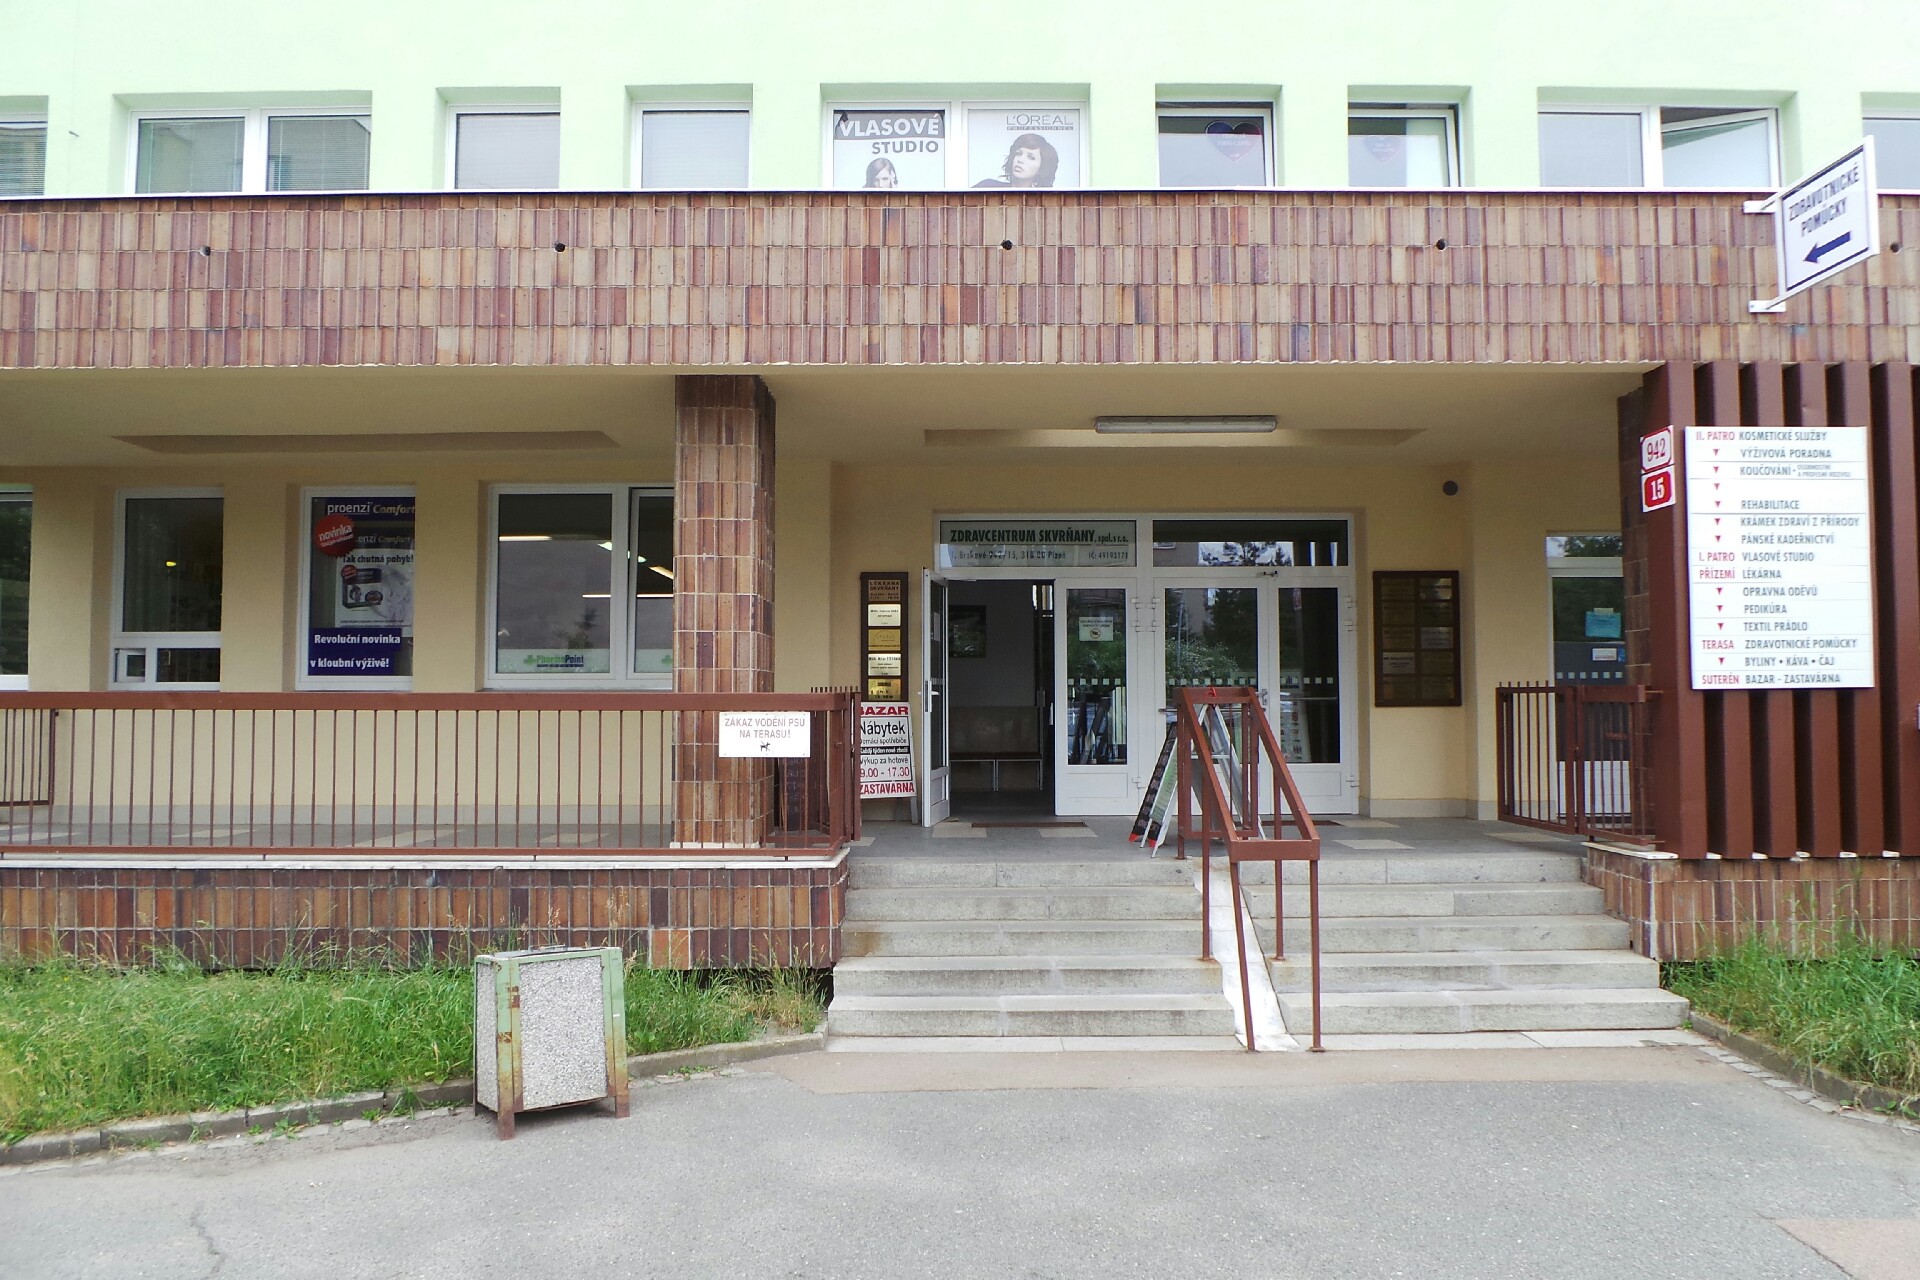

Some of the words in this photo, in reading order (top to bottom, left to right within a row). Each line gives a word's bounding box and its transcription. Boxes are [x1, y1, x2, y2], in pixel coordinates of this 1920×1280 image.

[839, 113, 939, 137] VLASOVÉ
[872, 141, 939, 154] STUDIO
[1789, 161, 1859, 221] ZDRAVOTNICKÉ
[1801, 196, 1847, 237] POMŮCKY
[1696, 431, 1705, 441] II.
[1707, 431, 1735, 441] PATRO
[1739, 430, 1793, 441] KOSMETICKÉ
[1795, 430, 1827, 441] SLUŽBY
[1647, 438, 1666, 462] 942
[1740, 447, 1786, 458] VÝŽIVOVÁ
[1789, 449, 1832, 458] PORADNA
[1740, 464, 1791, 476] KOUČOVÁNÍ
[1650, 476, 1665, 501] 15
[327, 501, 370, 515] proenzi
[373, 504, 415, 516] Comfort
[1741, 500, 1800, 510] REHABILITACE
[1740, 515, 1776, 527] KRÁMEK
[1778, 514, 1810, 527] ZDRAVÍ
[1812, 517, 1818, 527] Z
[1820, 514, 1859, 527] PŘÍRODY
[319, 524, 353, 541] novinka
[950, 529, 1036, 542] ZDRAVCENTRUM
[1741, 532, 1775, 545] PÁNSKÉ
[1777, 532, 1835, 545] KADEŘNICTVÍ
[359, 554, 385, 563] chutná
[386, 554, 414, 565] pohyb!
[1707, 552, 1735, 562] PATRO
[1742, 550, 1781, 562] VLASOVÉ
[1783, 552, 1815, 562] STUDIO
[1699, 567, 1736, 579] PŘÍZEMÍ
[1742, 567, 1782, 579] LÉKÁRNA
[1743, 587, 1785, 597] OPRAVNA
[1788, 585, 1818, 597] ODĚVŮ
[1744, 602, 1787, 614] PEDIKÚRA
[1744, 622, 1772, 632] TEXTIL
[1774, 620, 1808, 632] PRÁDLO
[314, 634, 360, 644] Revoluční
[362, 634, 401, 644] novinka
[1702, 640, 1735, 650] TERASA
[1744, 637, 1811, 649] ZDRAVOTNICKÉ
[1812, 636, 1857, 649] POMŮCKY
[310, 660, 316, 668] v
[318, 657, 354, 668] kloubní
[356, 658, 389, 670] výživě!
[1745, 657, 1776, 667] BYLINY
[1786, 655, 1809, 667] KÁVA
[1819, 654, 1835, 666] ČAJ
[1702, 672, 1740, 685] SUTERÉN
[1745, 675, 1775, 684] BAZAR
[1784, 672, 1841, 684] ZASTAVÁRNA
[724, 716, 753, 727] ZÁKAZ
[739, 729, 751, 738] NA
[753, 729, 791, 738] TERASU!
[879, 737, 907, 746] spotřebiče
[888, 766, 910, 777] 17.30
